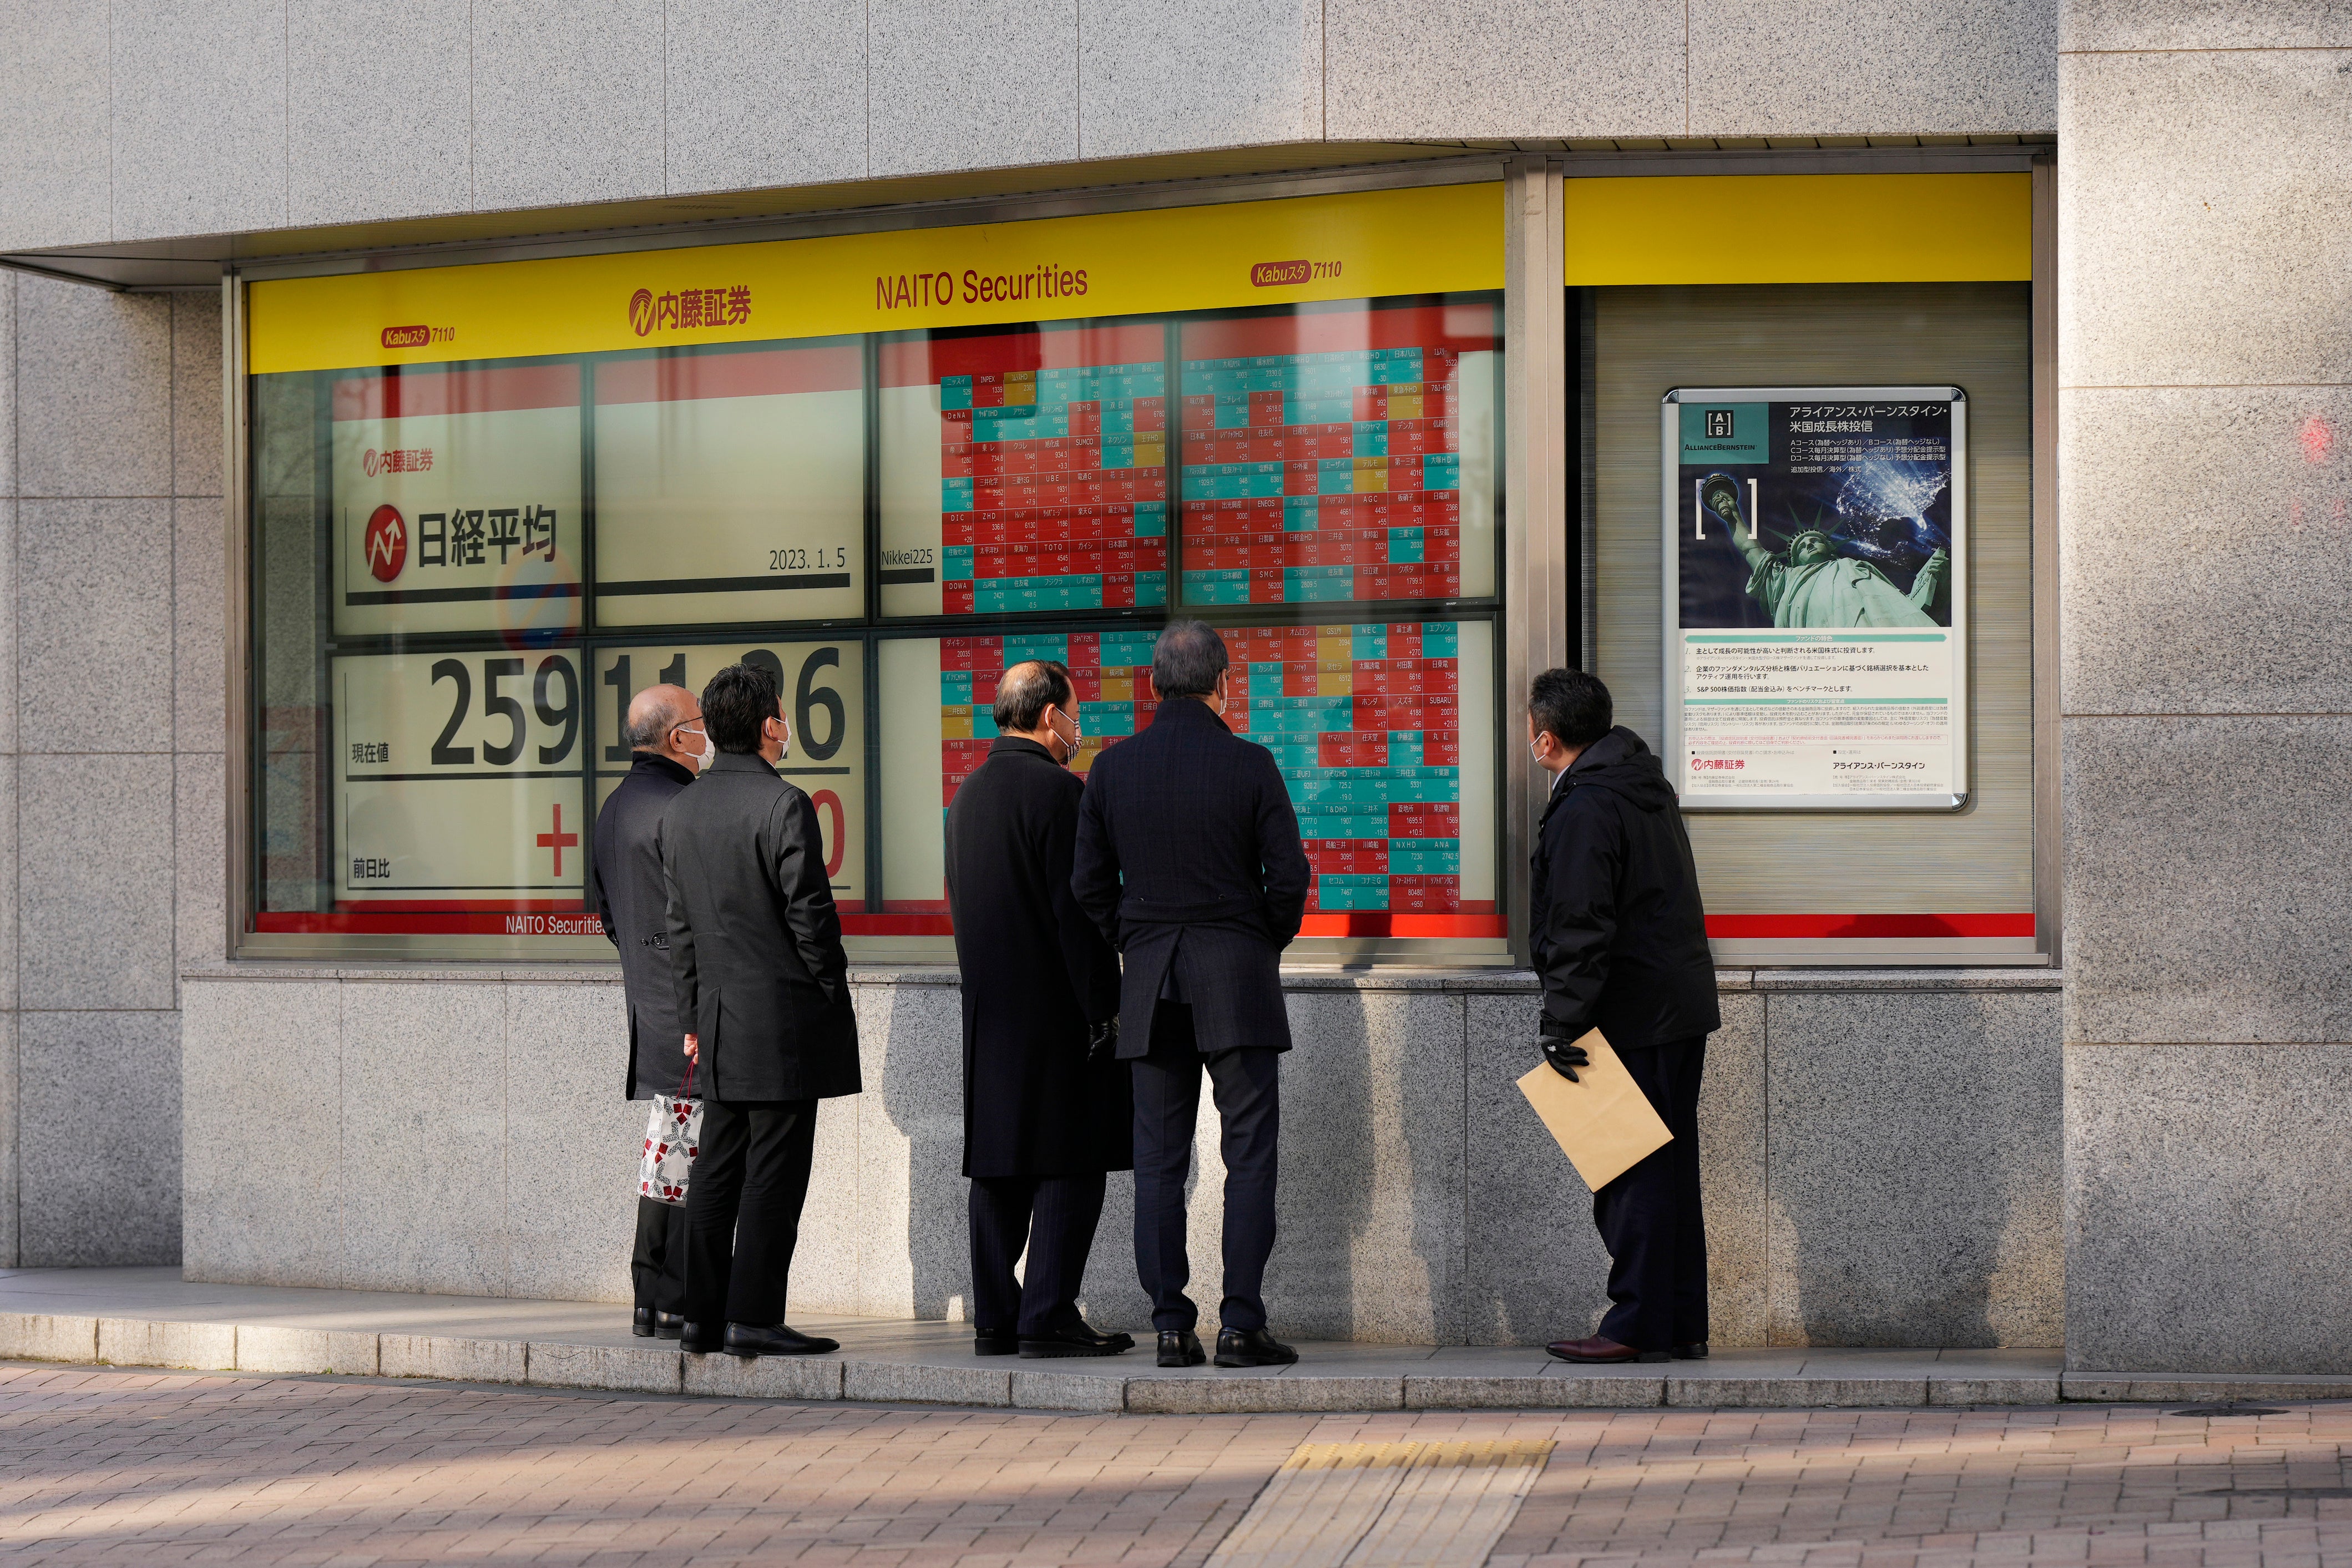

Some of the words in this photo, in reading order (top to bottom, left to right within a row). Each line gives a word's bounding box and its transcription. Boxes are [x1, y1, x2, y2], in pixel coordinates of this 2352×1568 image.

[1314, 261, 1341, 279] 7110
[877, 272, 953, 310] NAITO
[963, 264, 1087, 303] Securities
[658, 285, 751, 331] 内藤証券
[432, 327, 454, 342] 7110
[1715, 413, 1724, 422] A
[1789, 406, 1947, 418] アライアンス・バーンスタイン・
[1716, 426, 1723, 436] B
[1789, 421, 1873, 433] 米国成長株投信
[379, 448, 434, 474] 内藤証券
[418, 504, 556, 567] 日経平均
[882, 549, 932, 565] Nikkei225
[352, 742, 388, 763] 現在値
[1704, 760, 1745, 770] 内藤証券
[354, 858, 390, 878] 前日比
[507, 915, 544, 933] NAITO
